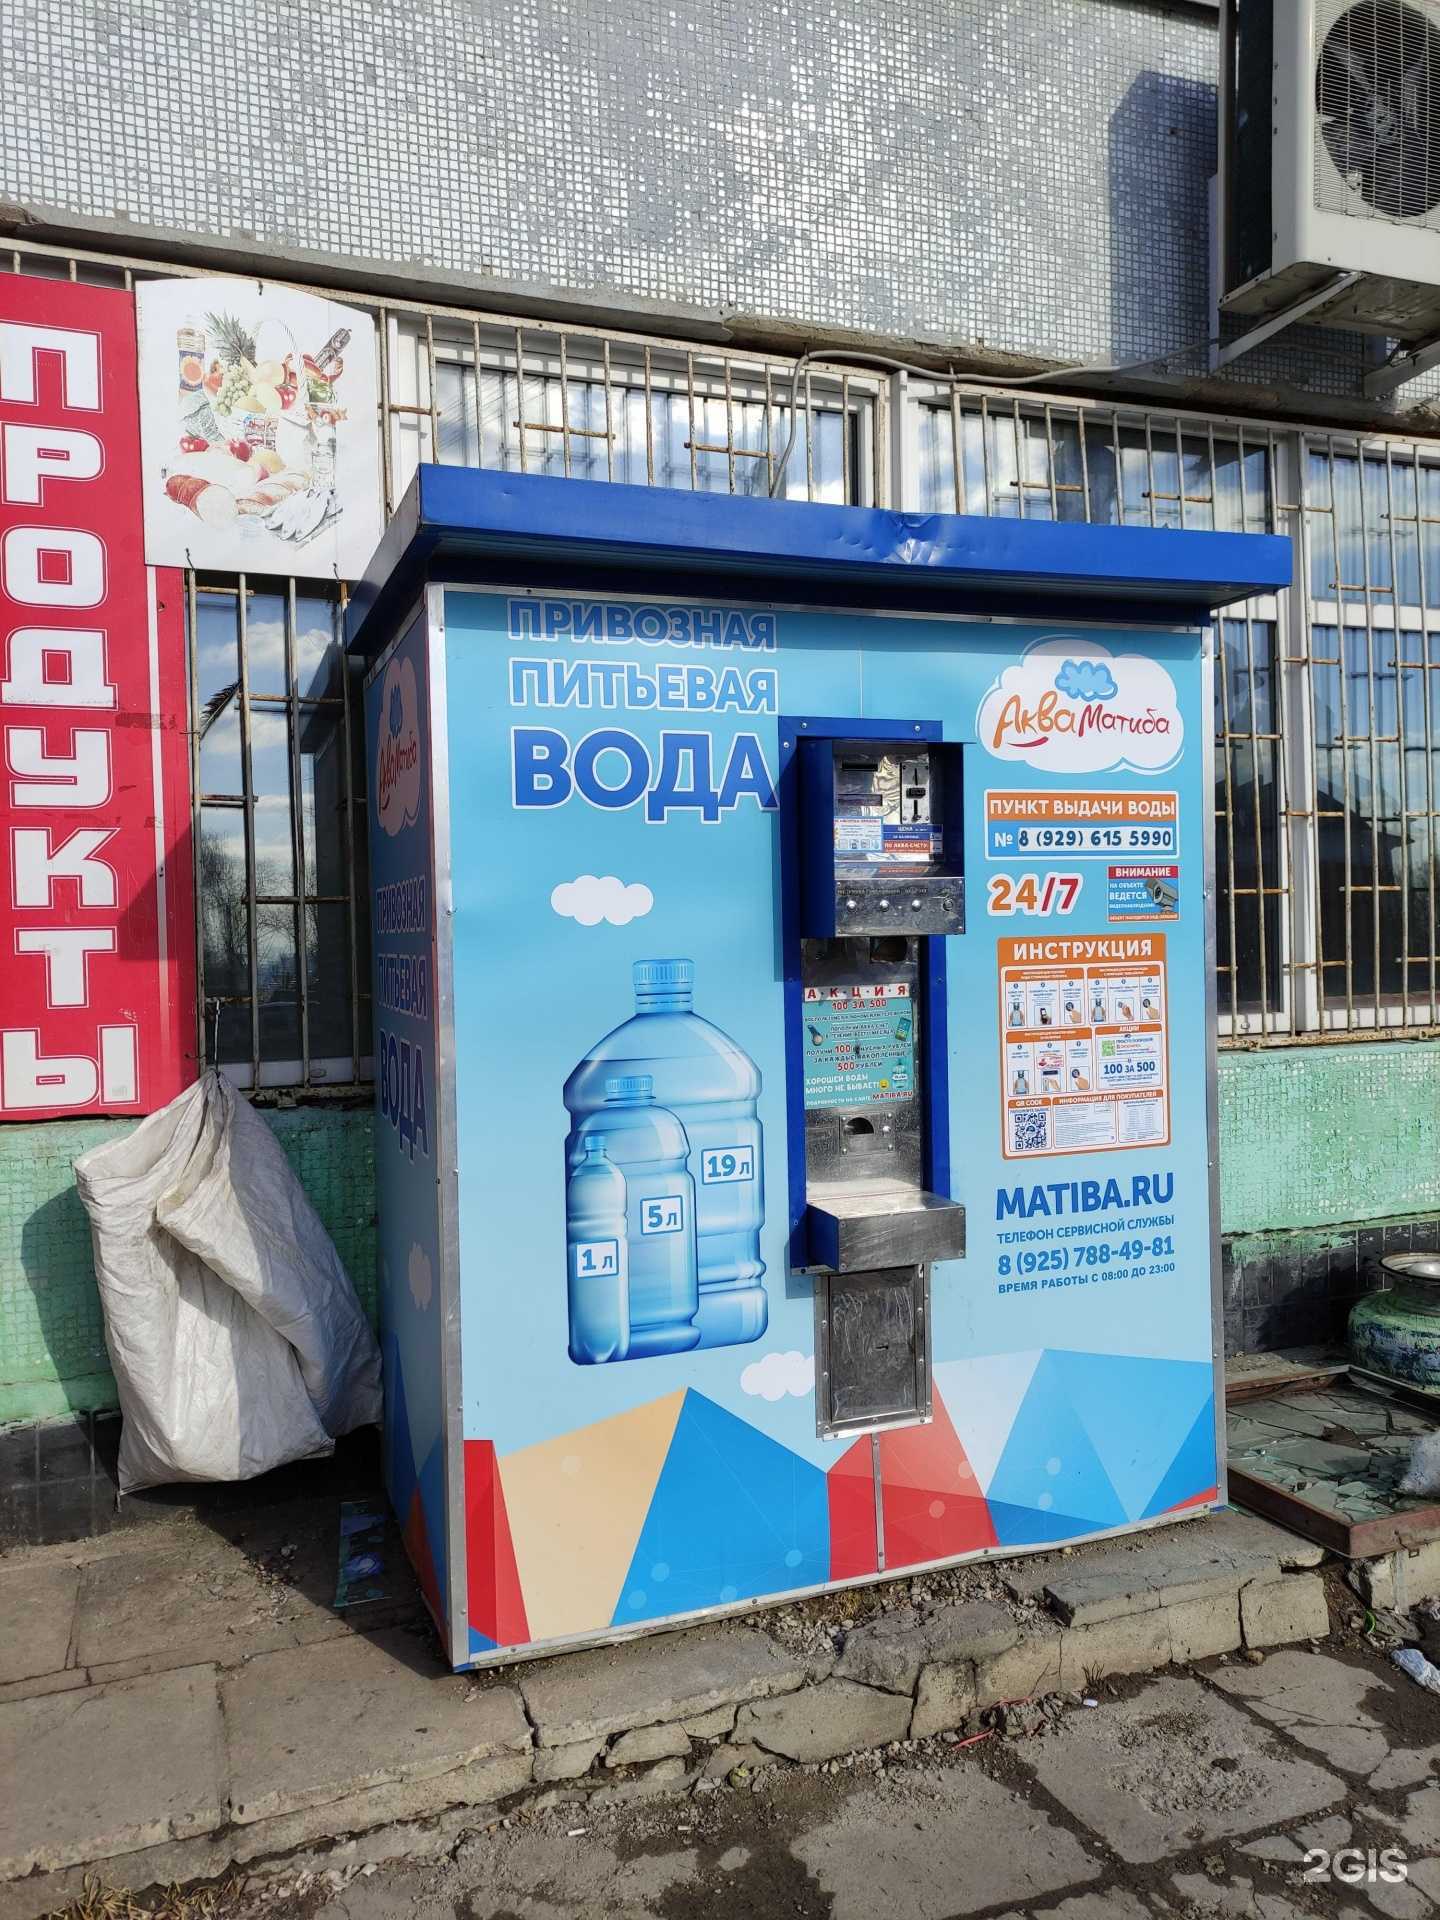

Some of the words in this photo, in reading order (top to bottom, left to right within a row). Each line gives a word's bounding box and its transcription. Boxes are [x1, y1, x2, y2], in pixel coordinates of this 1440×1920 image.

[507, 597, 777, 652] ПРИВОЗНАЯ
[509, 657, 778, 714] ПИТЬЕВАЯ
[0, 320, 140, 1114] ПРОДУКТЫ
[511, 725, 780, 824] ВОДА
[990, 799, 1048, 815] ПУНКТ
[1053, 800, 1123, 817] ВЫДАЧИ
[1128, 800, 1175, 817] ВОДЫ
[994, 832, 1013, 848] №
[1018, 830, 1029, 847] 8
[1036, 830, 1084, 848] (929)
[1091, 830, 1122, 847] 615
[1129, 830, 1172, 847] 5990
[1115, 867, 1171, 877] ВНИМАНИЕ
[990, 876, 1080, 913] 24/7
[1109, 891, 1147, 900] ВЕДЕТСЯ
[1013, 939, 1152, 960] ИНСТРУКЦИЯ
[832, 1001, 848, 1010] 100
[870, 999, 887, 1008] 500
[834, 1045, 850, 1053] 100
[837, 1062, 855, 1071] 500
[1104, 1063, 1122, 1074] 100
[1137, 1061, 1155, 1072] 500
[707, 1153, 736, 1179] 19
[996, 1172, 1174, 1221] MATIBA.RU
[648, 1204, 662, 1228] 5
[996, 1227, 1054, 1244] ТЕЛЕФОН
[1056, 1218, 1125, 1238] СЕРВИСНОЙ
[1127, 1214, 1175, 1229] СЛУЖБЫ
[582, 1248, 596, 1271] 1
[998, 1254, 1011, 1275] 8
[1017, 1247, 1069, 1275] (925)
[1073, 1236, 1175, 1268] 788-49-81
[998, 1281, 1038, 1293] ВРЕМЯ
[1041, 1275, 1088, 1289] РАБОТЫ
[1101, 1269, 1128, 1281] 08:00
[1131, 1266, 1146, 1278] ДО
[1149, 1263, 1175, 1274] 23:00
